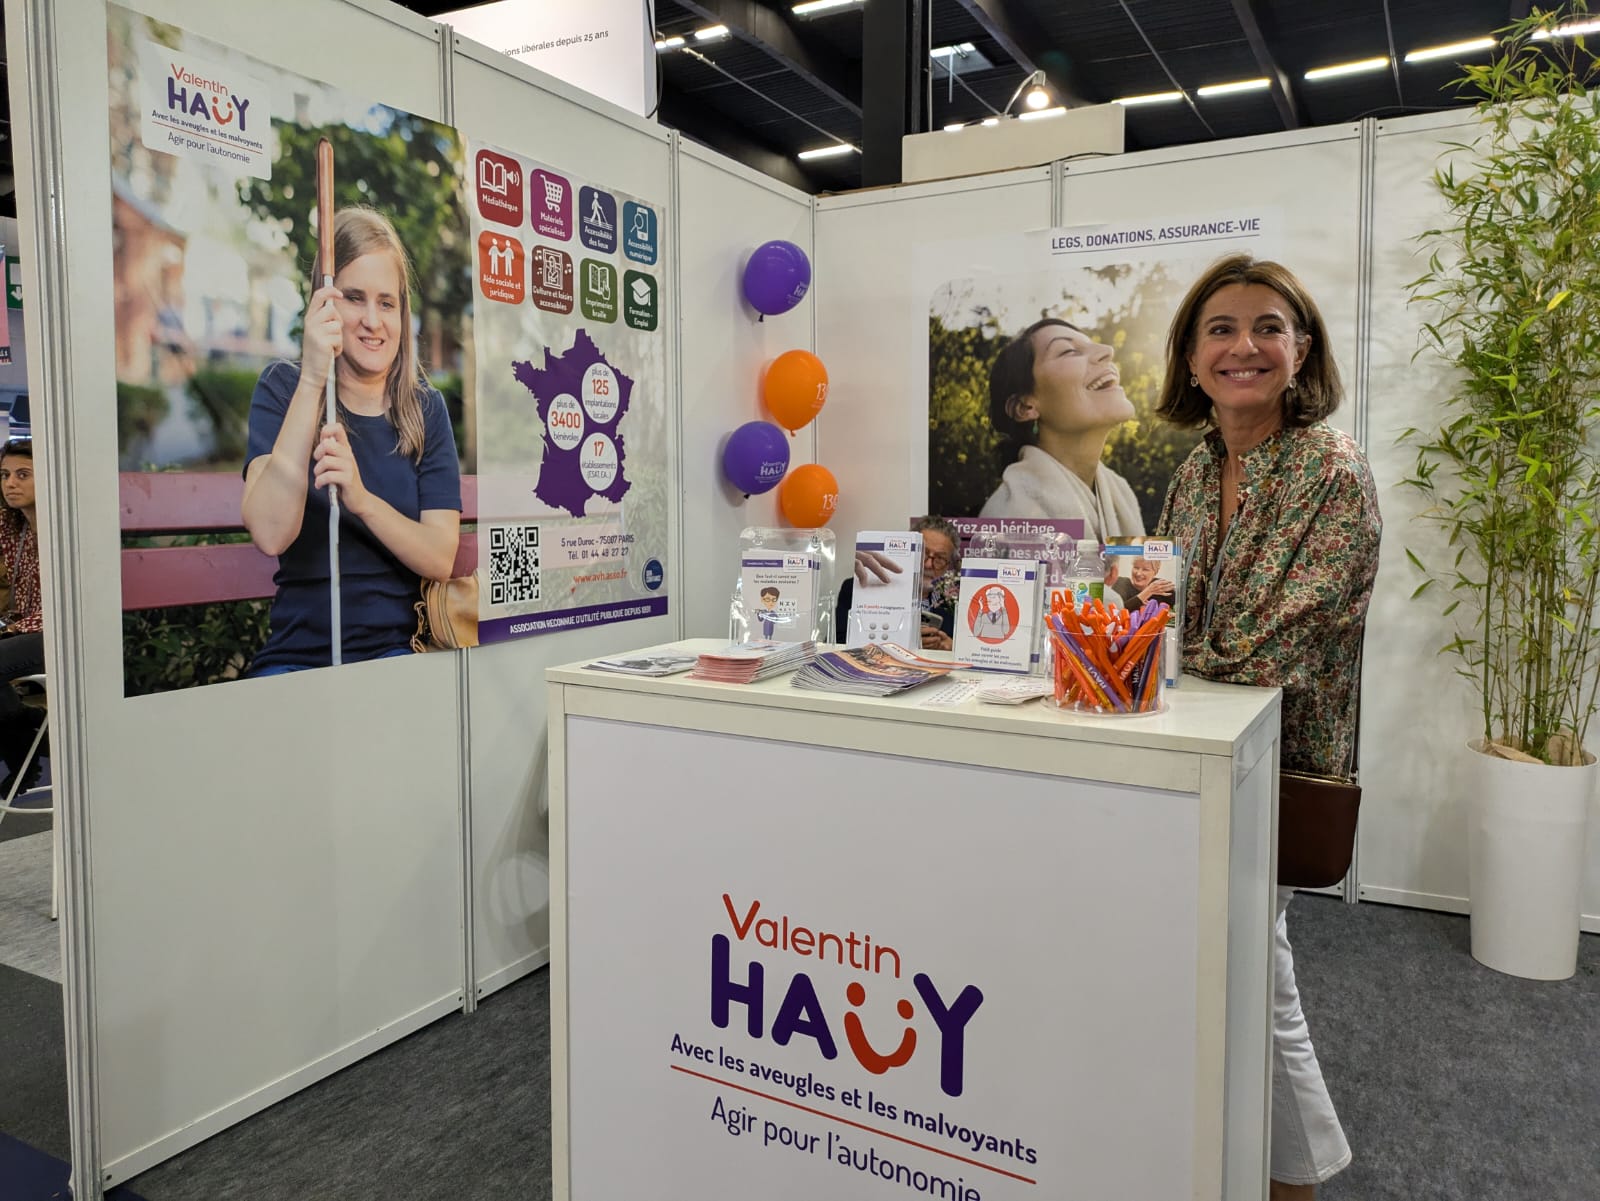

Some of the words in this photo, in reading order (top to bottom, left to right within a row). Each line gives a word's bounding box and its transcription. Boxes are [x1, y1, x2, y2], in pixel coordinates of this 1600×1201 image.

[522, 41, 555, 53] libérales
[556, 35, 582, 48] depuis
[584, 33, 593, 42] 25
[595, 29, 609, 39] ans
[171, 63, 228, 96] Valentin
[168, 76, 249, 131] HAÜY
[152, 110, 168, 121] Avec
[170, 114, 180, 125] les
[181, 119, 209, 134] aveugles
[210, 128, 217, 136] et
[218, 128, 228, 139] les
[228, 133, 263, 150] malvoyants
[168, 131, 184, 146] Agir
[186, 138, 205, 151] pour
[206, 142, 250, 164] l'autonomie
[482, 193, 519, 213] Médiathèque
[540, 211, 564, 227] Matériels
[538, 223, 566, 238] spécialisés
[584, 225, 613, 241] Accessibilité
[1051, 235, 1084, 250] LEGS,
[1086, 229, 1156, 247] DONATIONS,
[1158, 218, 1261, 240] ASSURANCE-VIE
[588, 238, 598, 246] des
[627, 238, 653, 253] Accessibilité
[483, 273, 495, 285] Aide
[495, 277, 514, 289] sociale
[514, 281, 521, 290] et
[489, 286, 515, 301] juridique
[532, 285, 552, 298] Culture
[552, 290, 558, 298] et
[539, 299, 567, 312] accessibles
[585, 297, 613, 311] Imprimeries
[592, 308, 607, 319] braille
[633, 316, 649, 328] Emploi
[592, 367, 602, 377] plus
[603, 368, 609, 377] de
[592, 378, 609, 396] 125
[556, 399, 567, 410] plus
[568, 401, 576, 409] de
[585, 399, 617, 410] implantations
[551, 411, 581, 429] 3400
[593, 410, 609, 420] locales
[553, 431, 580, 442] bénévoles
[594, 441, 604, 457] 17
[582, 460, 617, 470] établissements
[981, 522, 998, 534] en
[1000, 518, 1056, 535] héritage
[561, 537, 566, 547] 5
[566, 539, 577, 547] rue
[577, 536, 595, 546] Duroc
[599, 535, 618, 545] 75007
[618, 534, 635, 544] PARIS
[582, 549, 589, 559] 01
[590, 548, 600, 558] 44
[611, 547, 619, 557] 27
[621, 546, 629, 557] 27
[573, 569, 628, 584] www.avh.asso.fr
[509, 621, 547, 634] ASSOCIATION
[546, 616, 576, 628] RECONNUE
[575, 610, 600, 624] D'UTILITÉ
[600, 608, 624, 621] PUBLIQUE
[624, 606, 641, 617] DEPUIS
[722, 893, 901, 979] Valentin
[710, 933, 984, 1097] HAÜY
[670, 1033, 714, 1063] Avec
[718, 1045, 745, 1073] les
[749, 1060, 836, 1101] aveugles
[841, 1085, 862, 1109] et
[868, 1091, 898, 1120] les
[903, 1107, 1038, 1165] malvoyants
[710, 1095, 757, 1137] Agir
[763, 1119, 821, 1155] pour
[827, 1131, 981, 1201] l'autonomie
